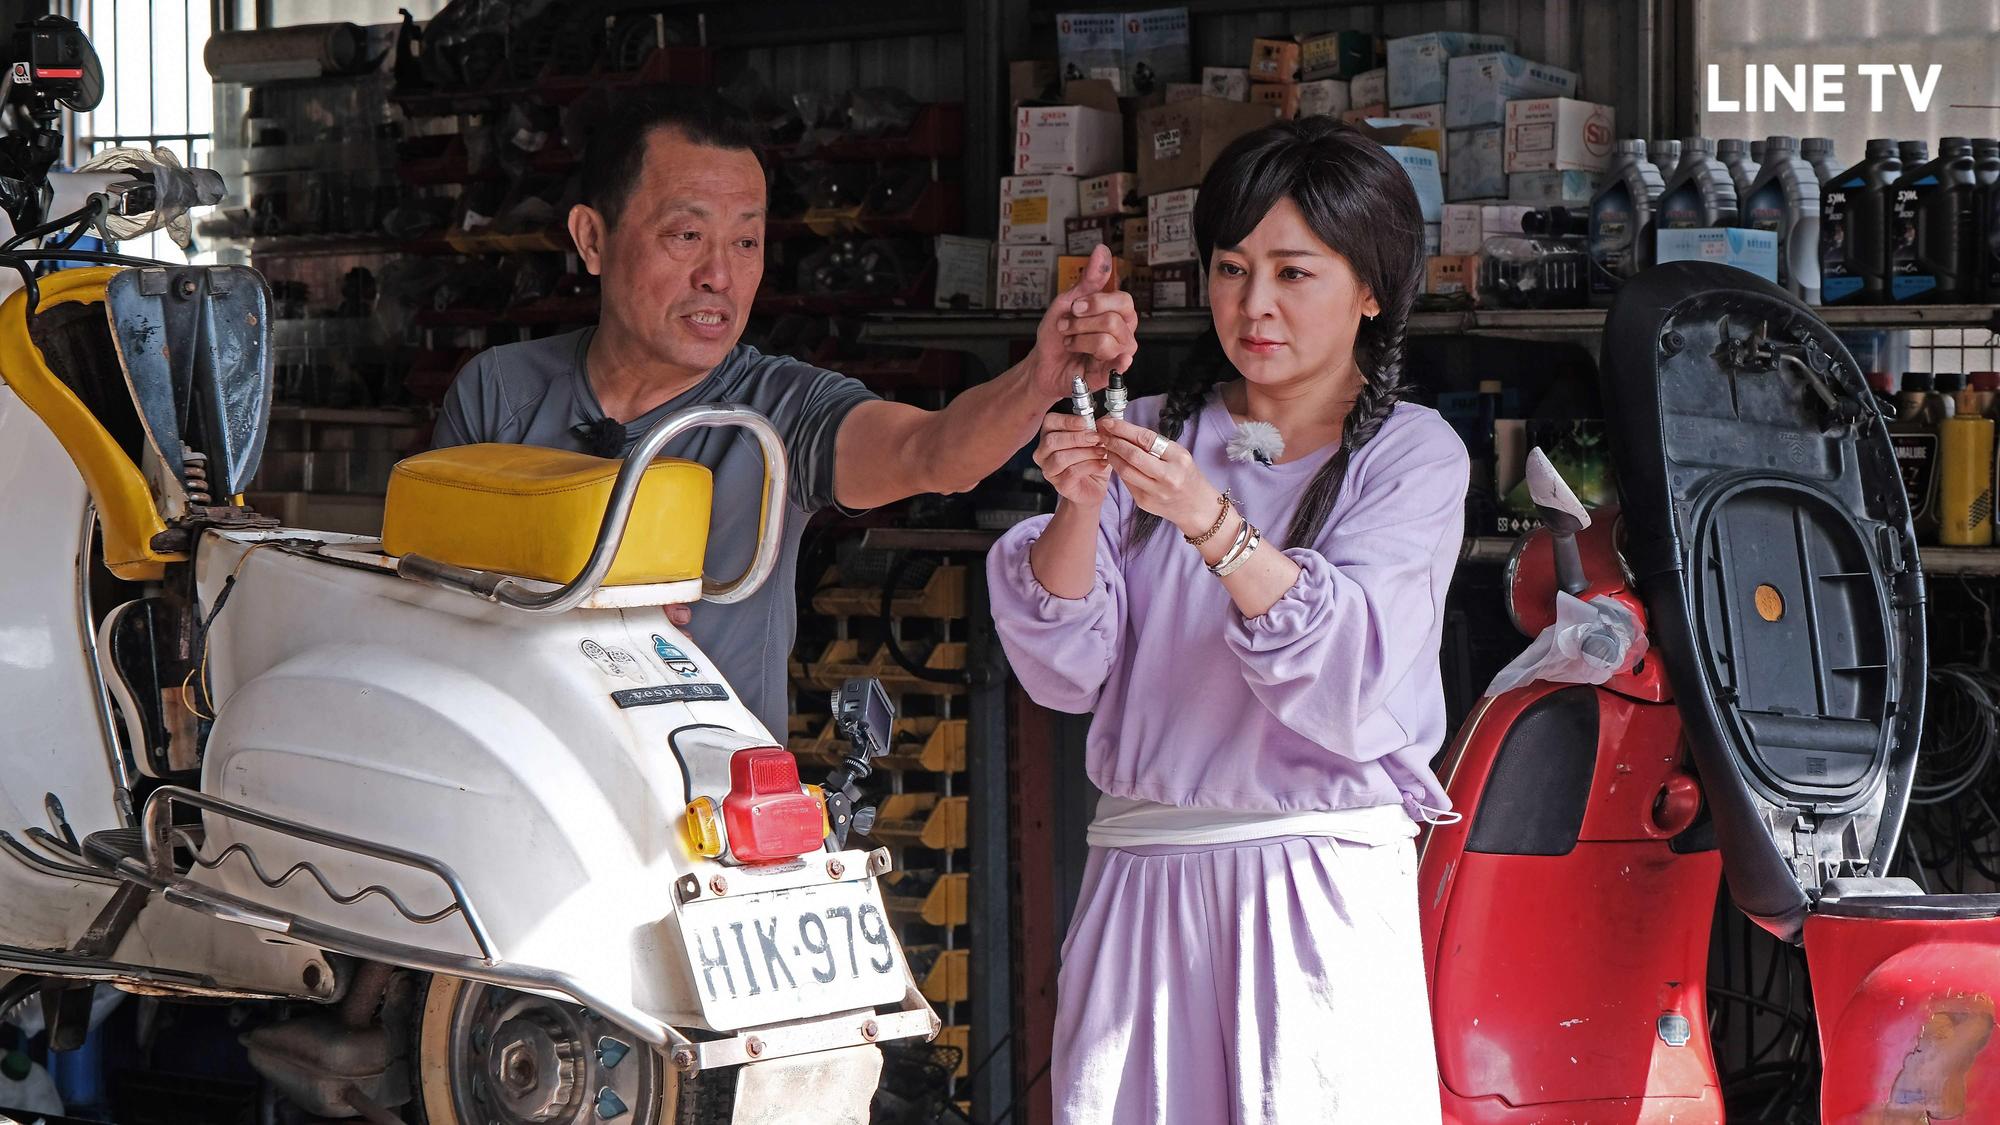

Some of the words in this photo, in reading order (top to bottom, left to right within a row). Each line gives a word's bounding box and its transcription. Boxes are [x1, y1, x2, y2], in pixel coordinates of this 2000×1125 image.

[1827, 192, 1846, 205] SYM
[1897, 190, 1918, 203] SYM
[632, 687, 685, 700] vespa
[693, 684, 713, 696] 90
